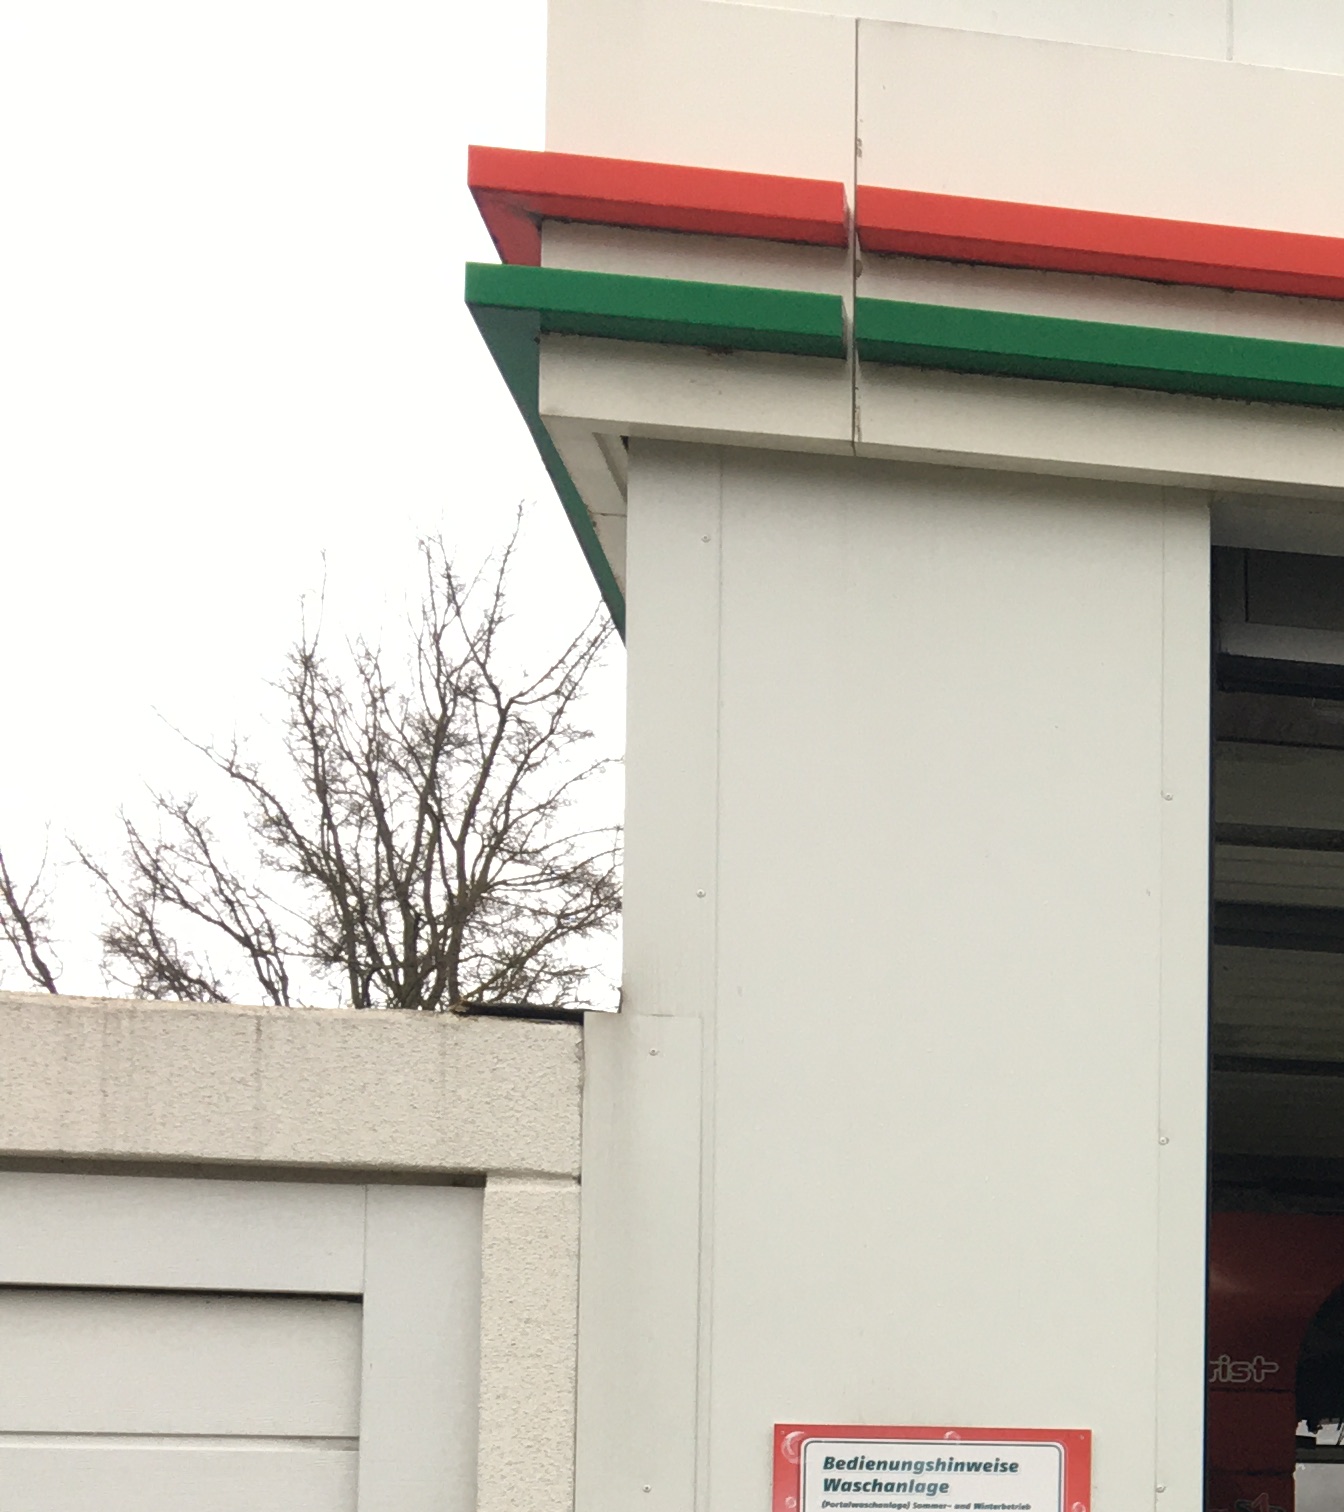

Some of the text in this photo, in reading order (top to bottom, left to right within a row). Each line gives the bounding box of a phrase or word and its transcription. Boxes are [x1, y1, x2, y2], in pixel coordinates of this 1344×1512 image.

[823, 1455, 1019, 1474] Bedienungshinweise
[823, 1478, 950, 1496] Waschanlage
[973, 1502, 1031, 1511] Winterbetrieb
